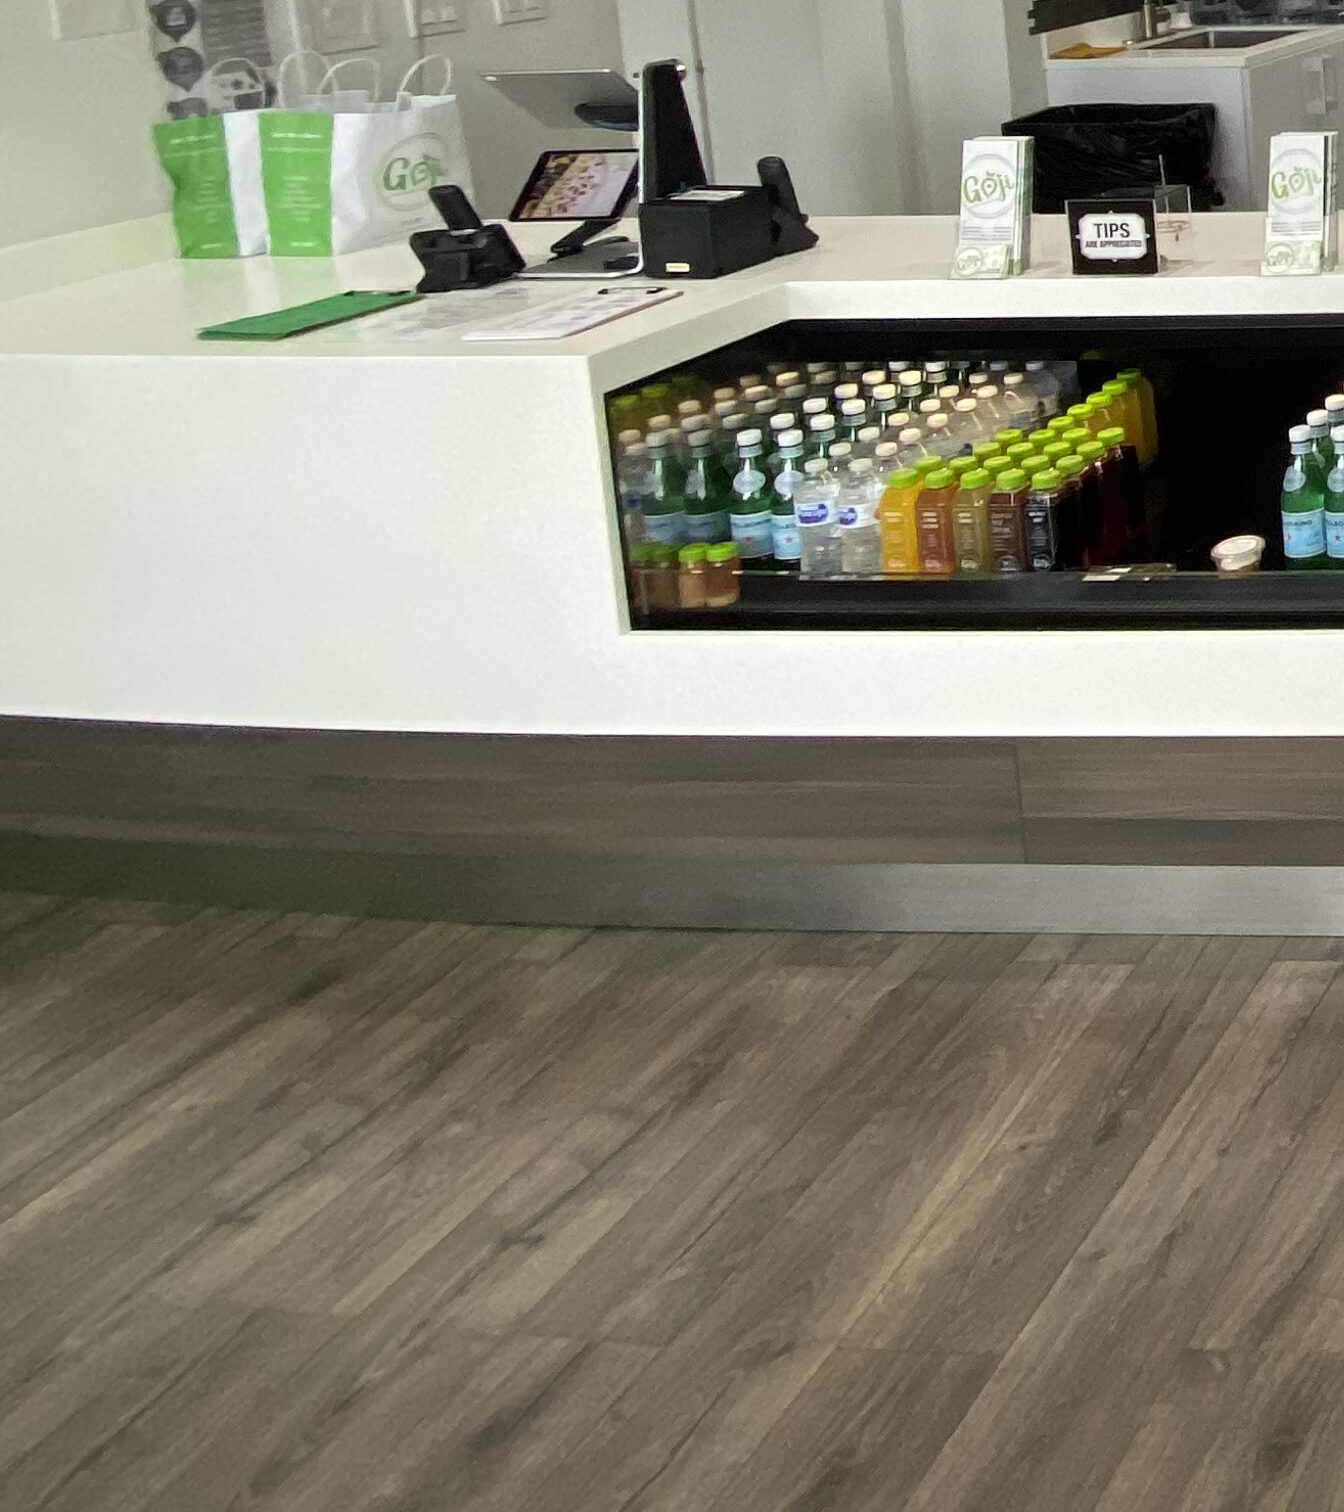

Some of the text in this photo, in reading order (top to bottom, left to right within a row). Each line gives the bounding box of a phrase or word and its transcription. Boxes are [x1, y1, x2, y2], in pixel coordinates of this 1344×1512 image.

[963, 171, 1015, 204] Goji
[1271, 167, 1322, 200] Goji
[1092, 222, 1130, 238] TIPS
